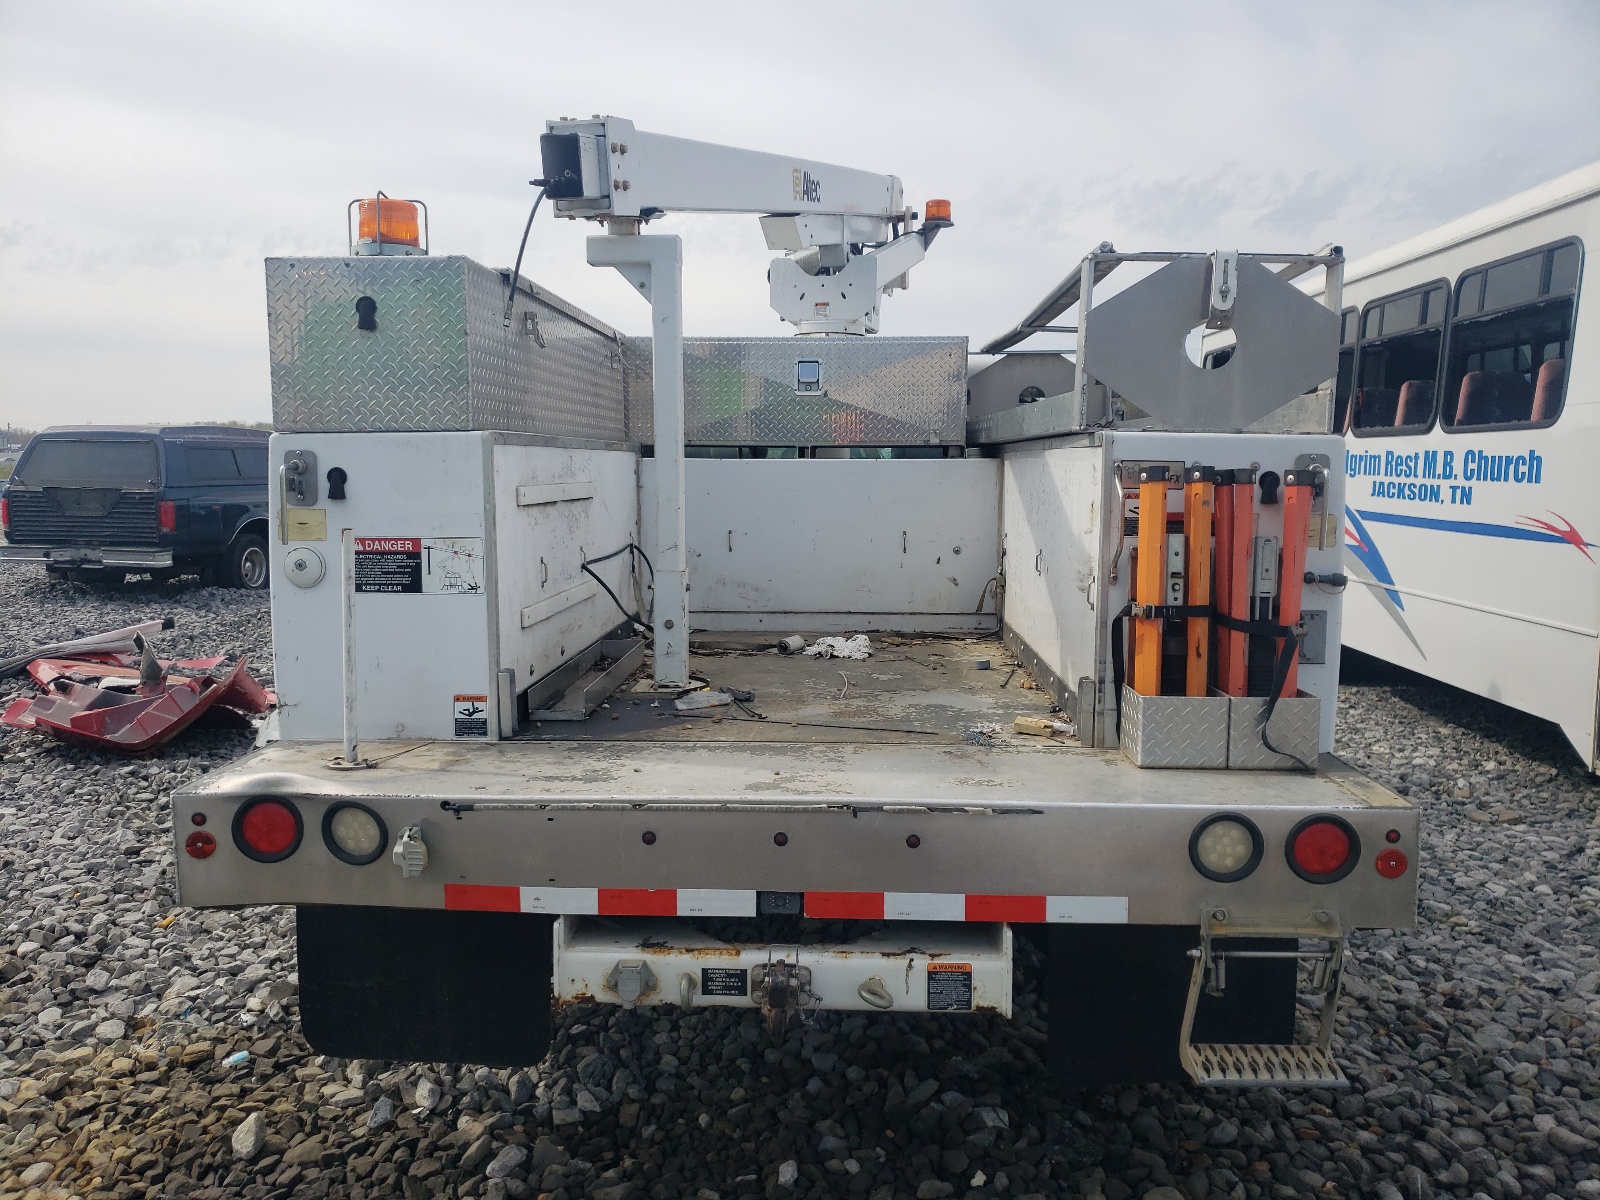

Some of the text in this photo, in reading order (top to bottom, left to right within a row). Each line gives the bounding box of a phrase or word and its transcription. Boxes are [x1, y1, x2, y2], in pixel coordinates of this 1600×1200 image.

[802, 170, 821, 203] Altec
[1345, 449, 1543, 484] lgrim Rest M.B. Church
[1370, 480, 1473, 505] JACKSON, TN
[365, 540, 413, 551] DANGER
